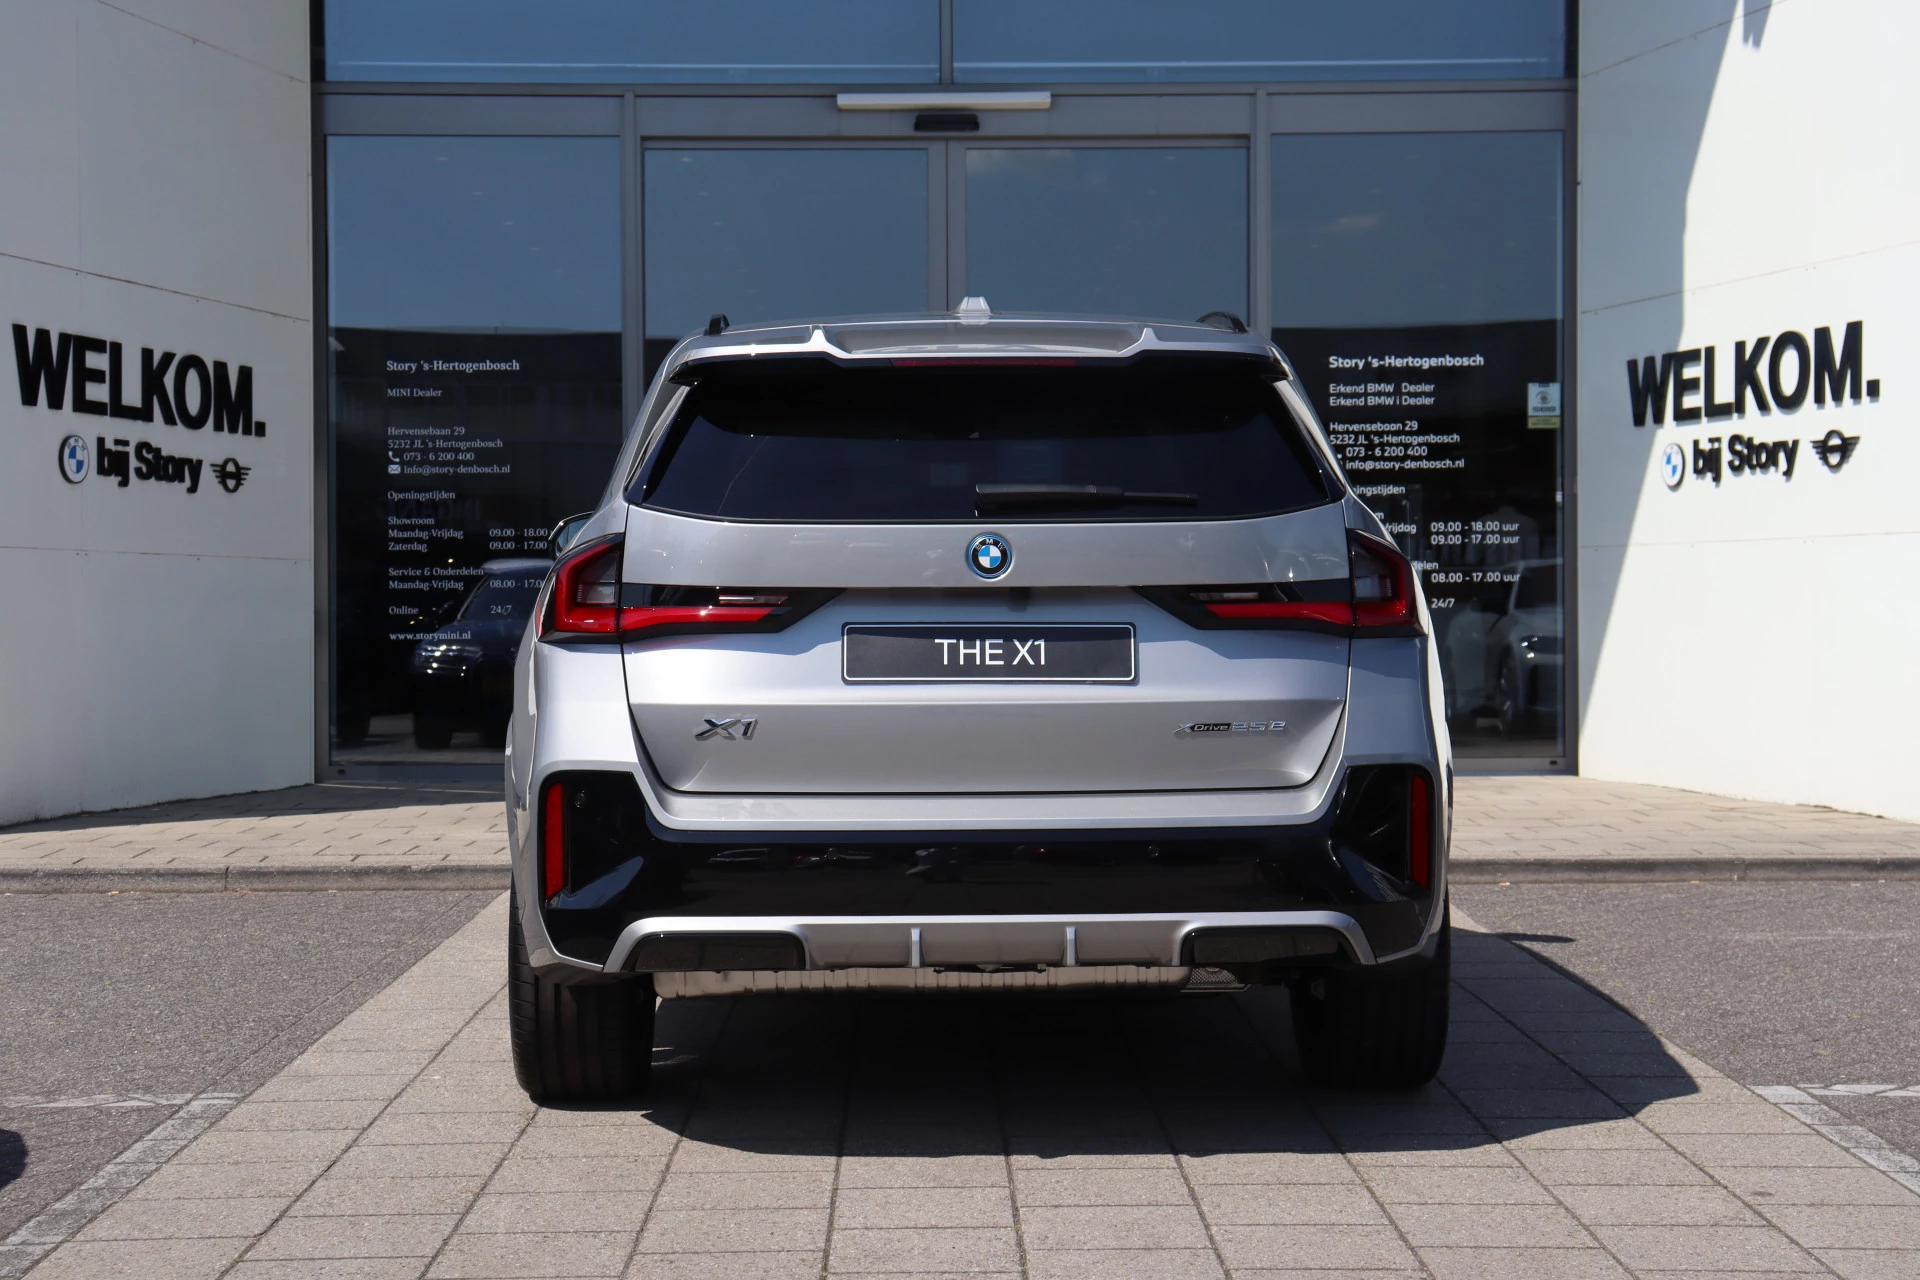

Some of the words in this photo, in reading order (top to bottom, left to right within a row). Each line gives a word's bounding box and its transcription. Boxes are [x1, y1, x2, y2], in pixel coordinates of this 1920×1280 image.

[387, 361, 417, 373] Story
[421, 360, 519, 373] 's-Hertogenbosch
[1329, 356, 1365, 369] Story
[1368, 354, 1484, 369] 's-Hertogenbosch
[1627, 320, 1880, 427] WELKOM.
[12, 323, 266, 437] WELKOM.
[388, 388, 410, 396] MINI
[414, 388, 442, 396] Dealer
[1330, 384, 1364, 393] Erkend
[1367, 383, 1394, 392] BMW
[1402, 383, 1434, 392] Dealer
[1330, 397, 1364, 406] Erkend
[1367, 396, 1394, 405] BMW
[1396, 395, 1399, 405] i
[1402, 396, 1435, 405] Dealer
[388, 427, 450, 435] Hervensebaan
[454, 427, 465, 435] 29
[1330, 422, 1402, 431] Hervensebaan
[1405, 421, 1418, 430] 29
[388, 440, 410, 448] 5232
[412, 439, 424, 448] JL
[426, 439, 502, 449] 's-Hertogenbosch
[1329, 434, 1355, 444] 5232
[1357, 434, 1368, 444] JL
[1371, 434, 1460, 447] 's-Hertogenbosch
[429, 452, 435, 461] 6
[438, 452, 455, 460] 200
[457, 452, 474, 460] 400
[1346, 447, 1365, 457] 073
[1374, 447, 1382, 457] 6
[1384, 447, 1404, 456] 200
[1407, 446, 1427, 456] 400
[1692, 437, 1722, 483] bij
[1728, 434, 1799, 478] Story
[97, 436, 130, 487] bij
[134, 441, 203, 494] Story
[404, 465, 510, 475] info@story-denbosch.nl
[1346, 459, 1464, 471] info@story-denbosch.nl
[388, 491, 455, 501] Openingstijden
[1354, 484, 1406, 497] ingstijden
[388, 516, 434, 524] Showroom
[1431, 522, 1461, 532] 09.00
[1471, 521, 1499, 531] 18.00
[1502, 522, 1520, 531] uur
[389, 529, 463, 539] Maandag-Vrijdag
[523, 528, 548, 537] 18.00
[1431, 535, 1461, 544] 09.00
[1502, 535, 1520, 544] uur
[389, 542, 427, 552] Zaterdag
[523, 541, 547, 550] 17.00
[389, 568, 422, 576] Service
[424, 567, 431, 576] &
[432, 567, 484, 576] Onderdelen
[1431, 573, 1462, 582] 08.00
[1503, 573, 1520, 582] uur
[389, 580, 463, 590] Maandag-Vrijdag
[489, 579, 516, 588] 08.00
[1431, 599, 1455, 609] 24/7
[389, 606, 418, 614] Online
[490, 605, 512, 615] 24/7
[389, 631, 471, 641] www.storymini.nl
[935, 638, 1004, 665] THE
[1012, 638, 1046, 665] X1
[695, 718, 758, 739] X1
